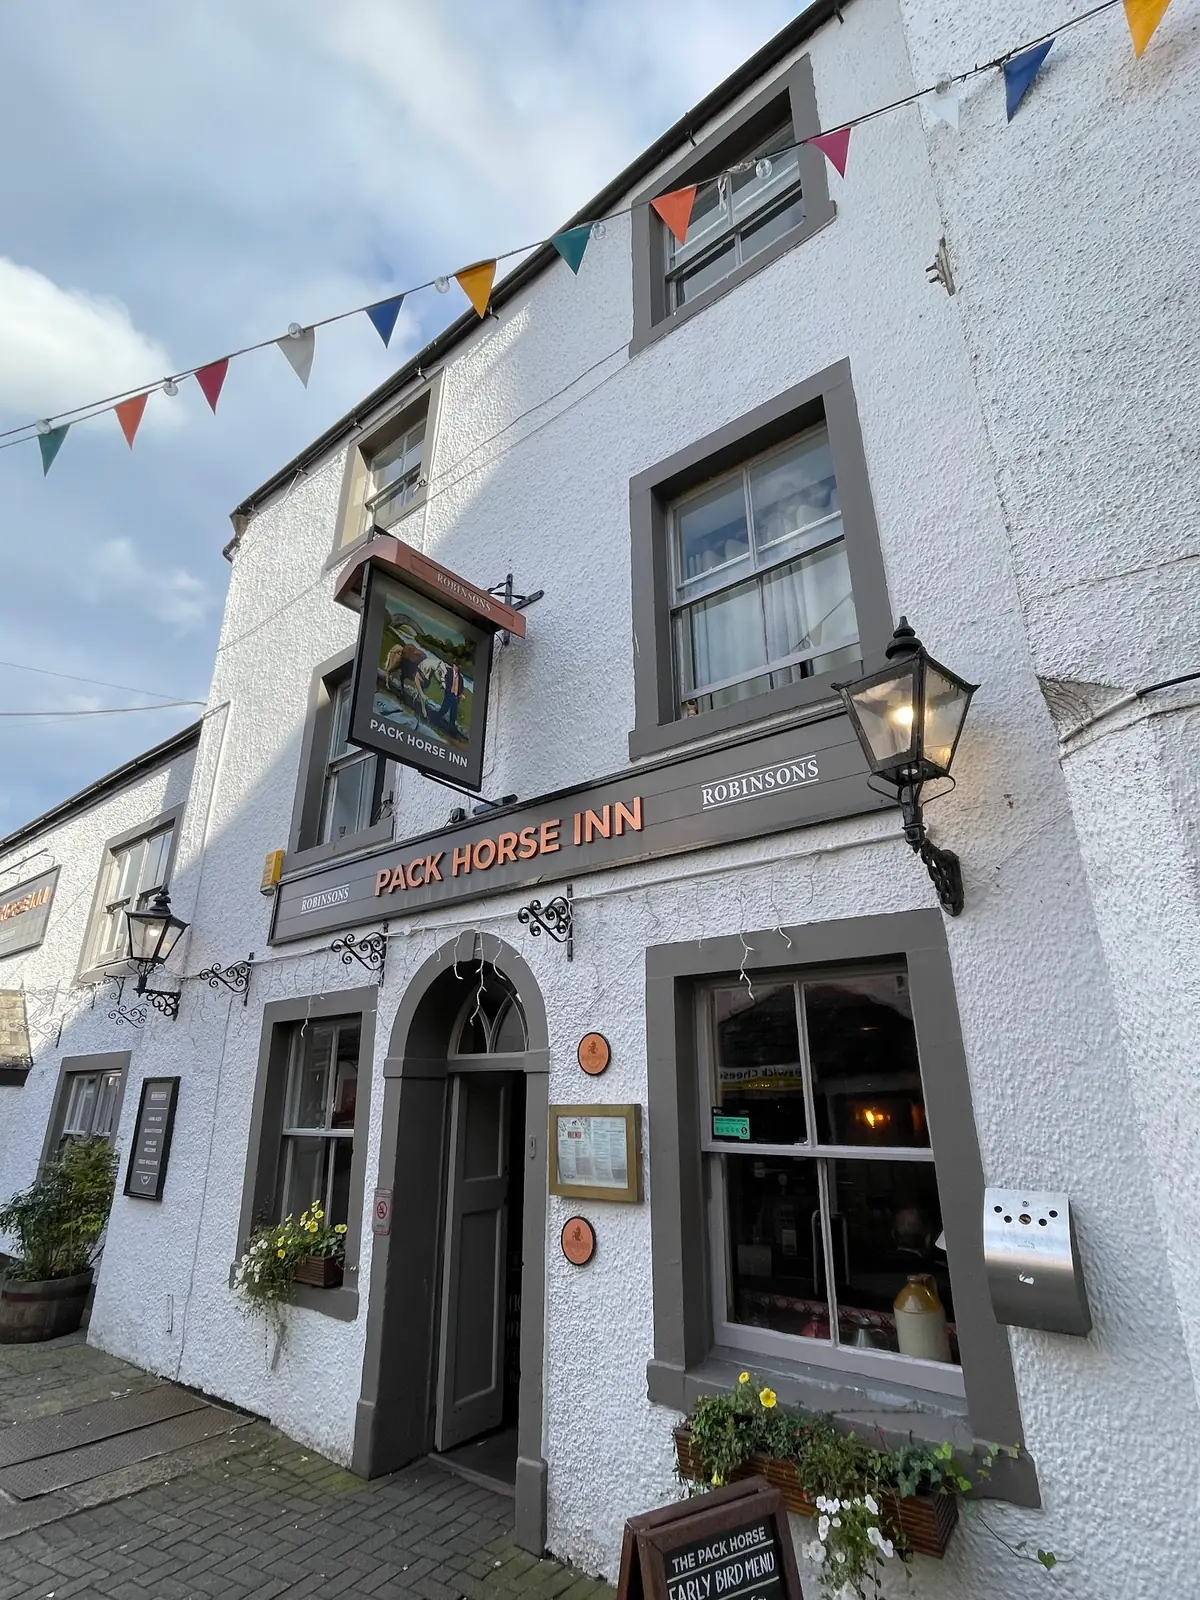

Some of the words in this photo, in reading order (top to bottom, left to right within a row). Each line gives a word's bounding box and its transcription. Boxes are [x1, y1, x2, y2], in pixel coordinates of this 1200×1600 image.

[436, 573, 492, 612] ROBINSONS
[370, 718, 403, 742] PACK
[407, 734, 446, 759] HORSE
[449, 751, 468, 768] INN
[701, 759, 820, 806] ROBINSONS
[374, 852, 444, 897] PACK
[452, 819, 561, 877] HORSE
[573, 796, 643, 846] INN
[301, 887, 350, 911] ROBINSONS
[672, 1552, 696, 1573] THE
[698, 1540, 728, 1564] PACK
[729, 1526, 767, 1552] HORSE
[668, 1573, 712, 1600] EARLY
[715, 1563, 744, 1593] BIRD
[744, 1551, 775, 1581] MENU
